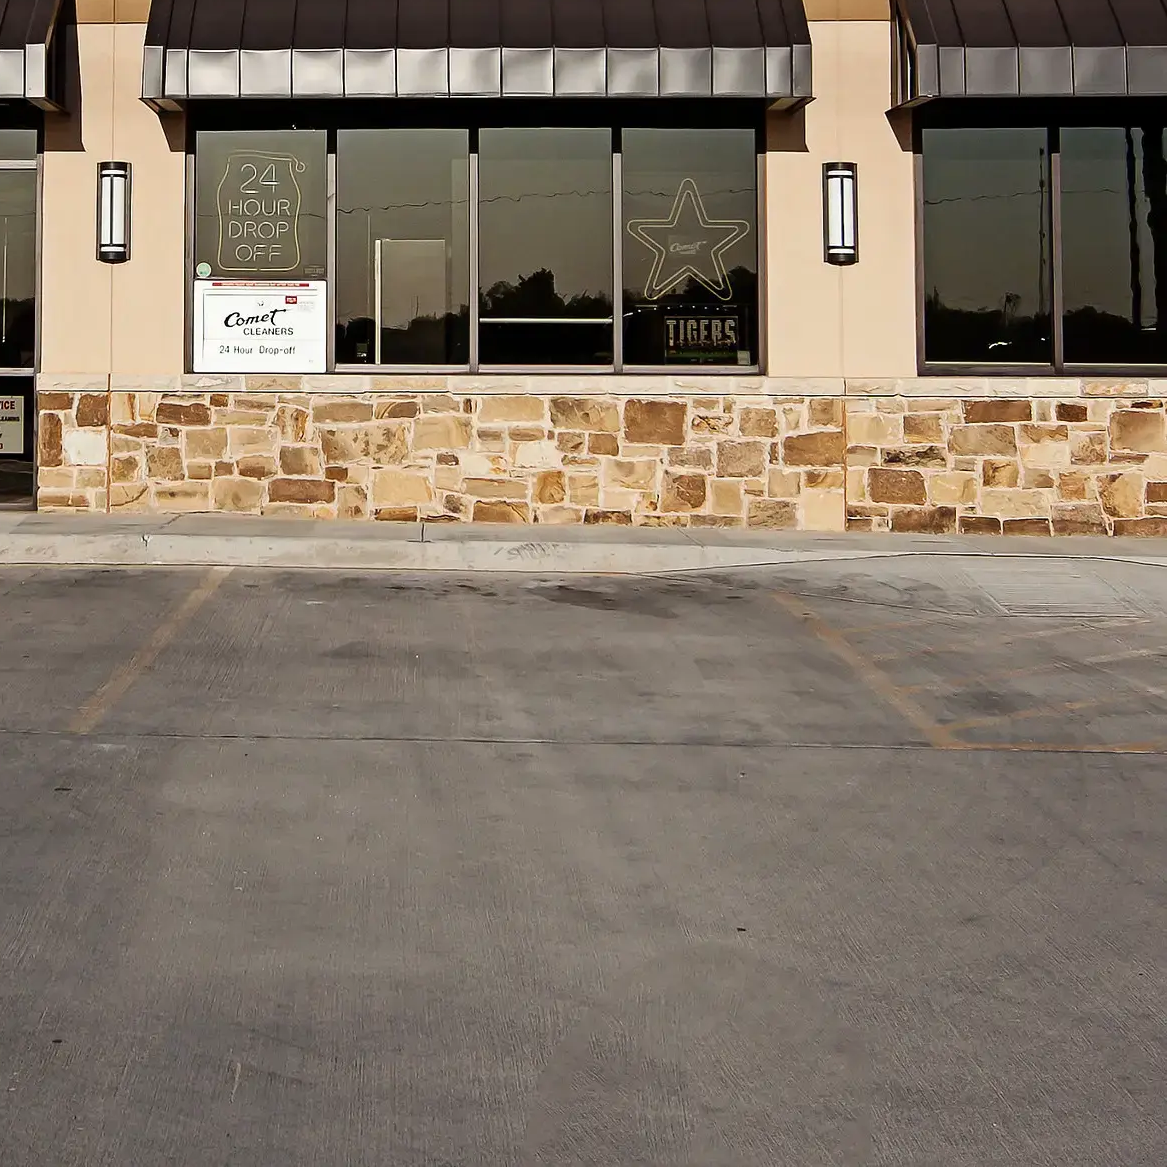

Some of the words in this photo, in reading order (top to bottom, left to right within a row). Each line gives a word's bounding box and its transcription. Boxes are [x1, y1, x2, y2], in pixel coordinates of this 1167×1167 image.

[240, 163, 280, 193] 24
[228, 199, 291, 216] HOUR
[228, 221, 289, 238] DROP
[235, 244, 282, 262] OFF
[224, 309, 291, 327] Comet
[666, 320, 736, 346] TIGERS
[219, 346, 230, 354] 24
[233, 346, 253, 354] Hour
[259, 345, 296, 355] Drop-off
